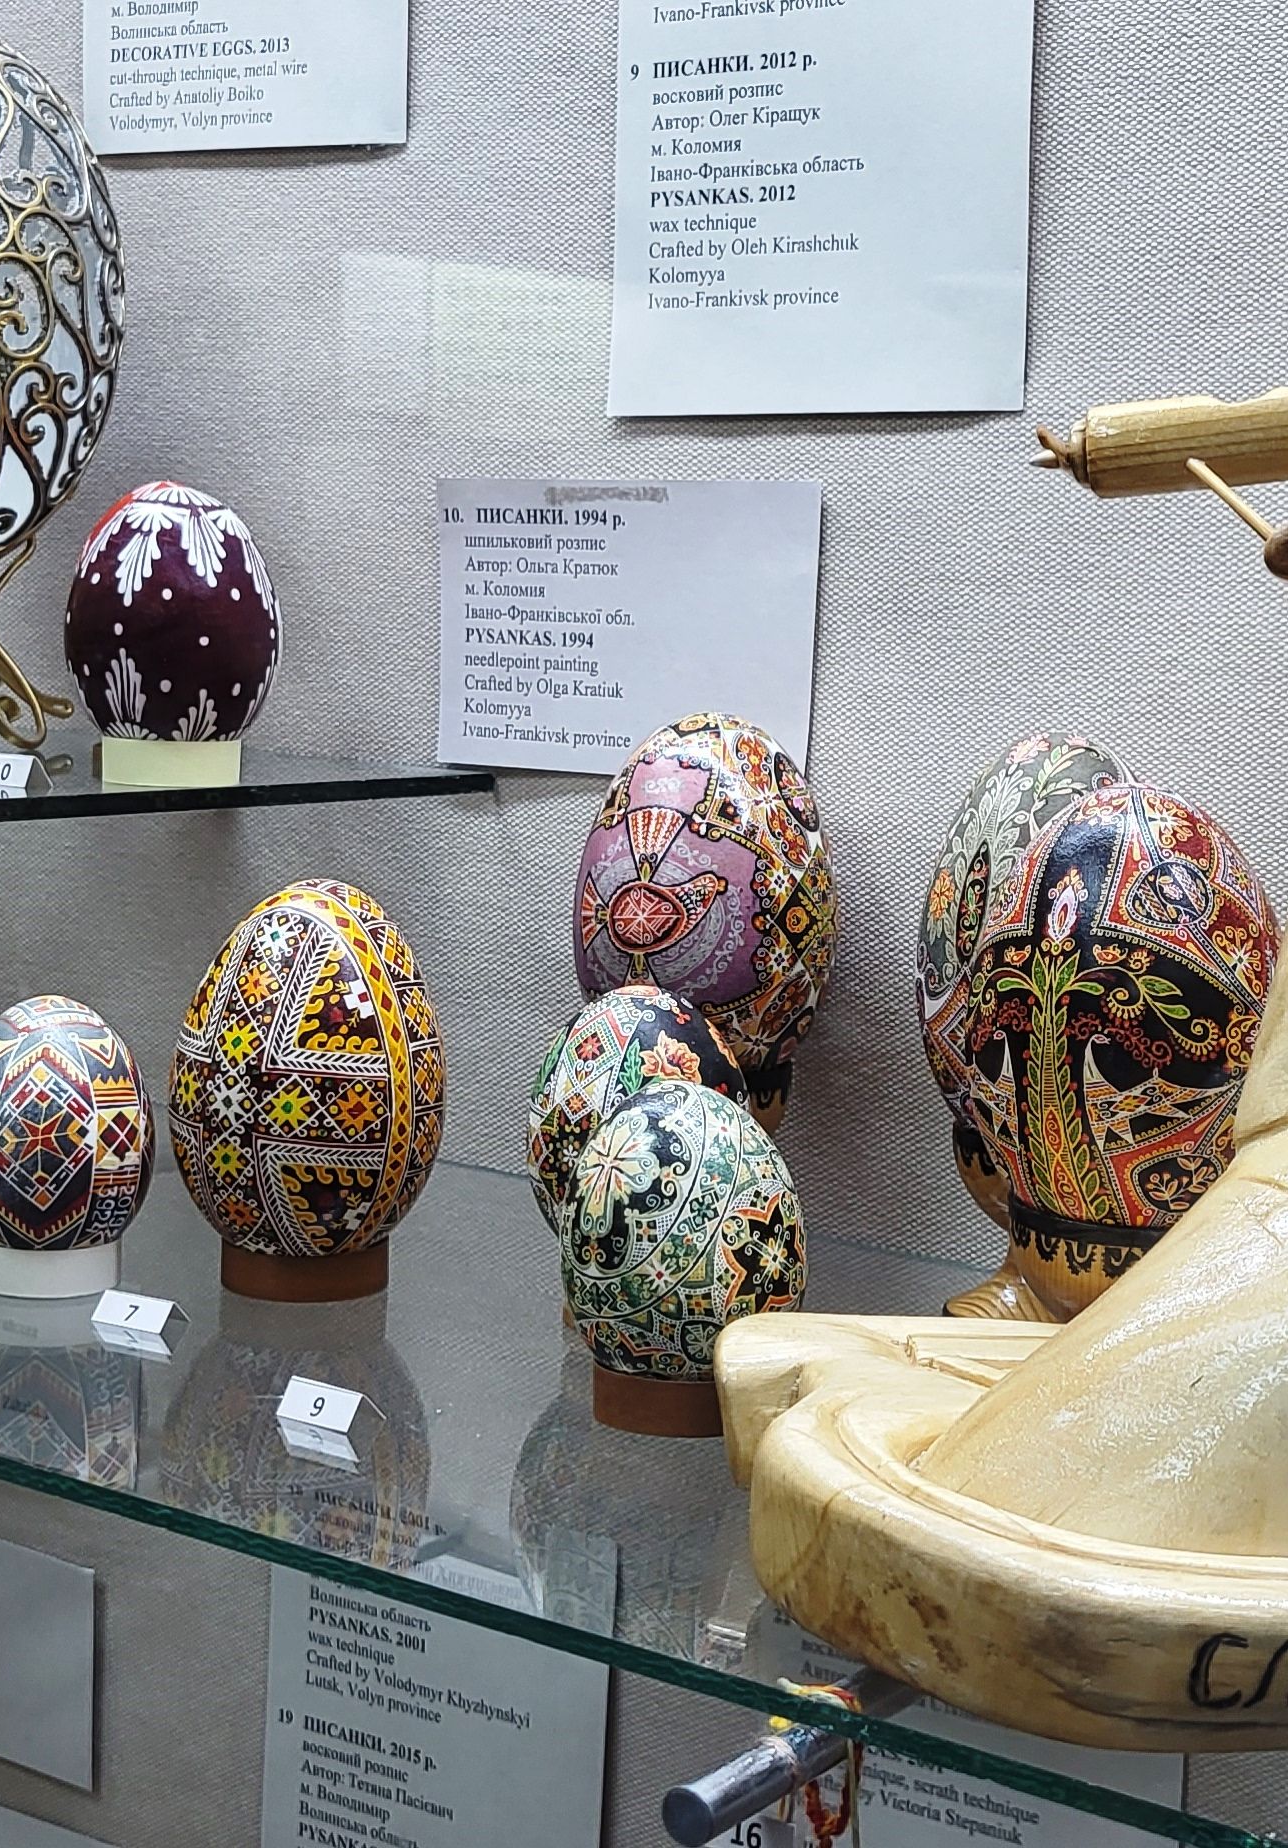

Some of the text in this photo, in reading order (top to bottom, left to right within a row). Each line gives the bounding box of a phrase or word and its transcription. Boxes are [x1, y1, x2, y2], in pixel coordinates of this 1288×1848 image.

[111, 1, 198, 17] м. Володимир
[654, 0, 775, 23] Ivano-Frankivsk
[111, 19, 228, 40] Волинська область
[111, 37, 289, 62] DECORATIVE EGGS. 2013
[110, 59, 307, 86] cut-through technique, metal wire
[631, 52, 816, 80] 9 ПИСАНКИ. 2012 р.
[109, 85, 263, 109] Crafted by Anatoliy Boiko
[653, 83, 783, 105] восковий розпис
[109, 108, 272, 133] Volodymyr, Volyn province
[651, 106, 820, 133] Автор: Олег Кіращук
[651, 139, 741, 156] м. Коломия
[651, 155, 864, 183] Івано-Франківська область
[651, 184, 795, 207] PYSANKAS. 2012
[649, 213, 756, 234] wax technique
[649, 233, 859, 260] Crafted by Oleh Kirashchuk
[649, 266, 724, 286] Kolomyya
[649, 287, 838, 310] Ivano-Frankivsk province
[444, 508, 625, 530] 10. ПИСАНКИ. 1994 р.
[465, 534, 606, 554] шпильковий розпис
[465, 556, 618, 578] Автор: Ольга Кратюк
[465, 580, 545, 597] м. Коломия
[465, 603, 634, 625] Івано-Франківської обл.
[465, 627, 593, 648] PYSANKAS. 1994
[465, 651, 598, 676] needlepoint painting
[465, 674, 623, 698] Crafted by Olga Kratiuk
[463, 697, 531, 720] Kolomyya
[463, 721, 630, 748] Ivano-Frankivsk province
[124, 1305, 139, 1321] 7
[310, 1397, 325, 1416] 9
[310, 1585, 431, 1632] Волинська область
[309, 1606, 425, 1653] PYSANKAS. 2001
[308, 1630, 394, 1665] wax technique
[306, 1669, 441, 1723] Lutsk, Volyn province
[307, 1649, 529, 1728] Crafted by Volodymyr Khyzhynskyi
[279, 1708, 436, 1771] 19 ПИСАНКИ. 2015 р.
[303, 1740, 408, 1783] восковий розпис
[301, 1760, 453, 1820] Автор: Тетяна Пасієвич
[731, 1820, 762, 1848] 16
